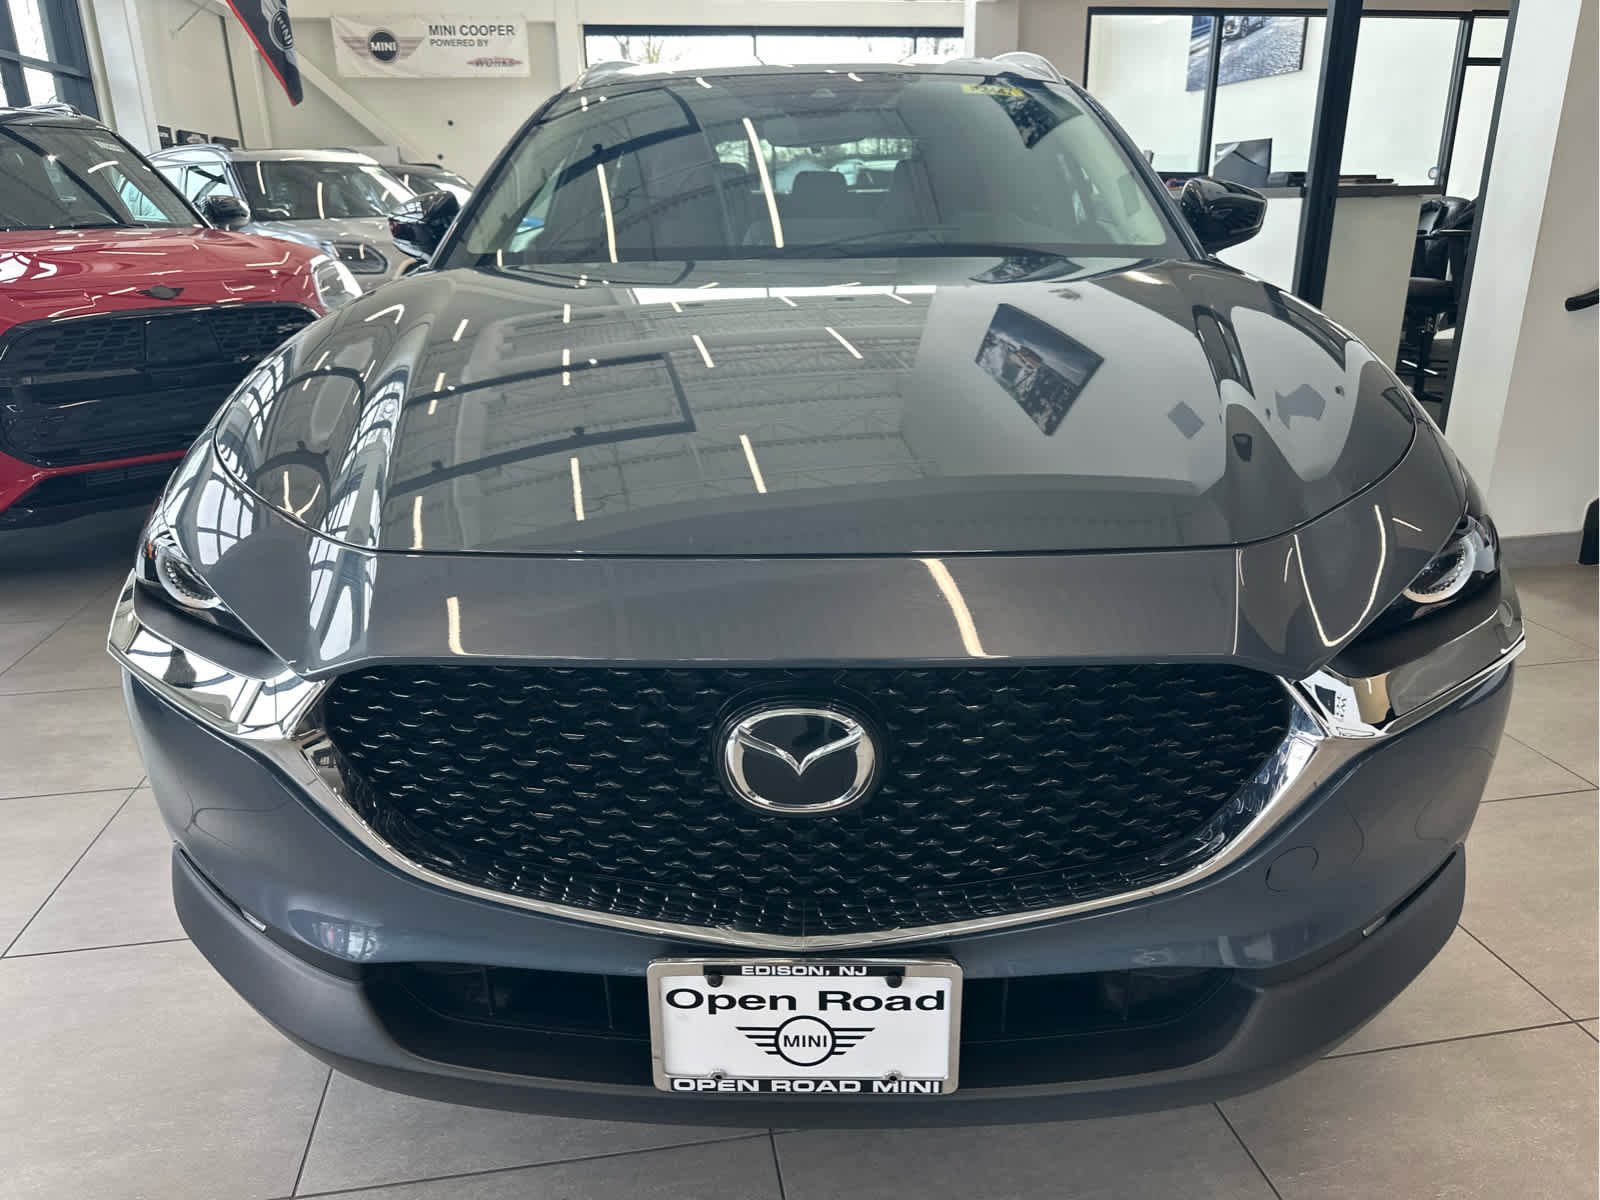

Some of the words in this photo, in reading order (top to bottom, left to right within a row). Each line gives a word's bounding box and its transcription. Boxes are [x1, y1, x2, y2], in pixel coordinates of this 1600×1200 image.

[428, 25, 456, 36] MINI
[459, 24, 515, 36] COOPER
[369, 41, 397, 52] MINI
[430, 38, 476, 47] POWERED
[477, 39, 488, 47] BY
[740, 965, 830, 976] EDISON,
[839, 966, 868, 976] NJ
[665, 987, 797, 1015] Open
[817, 990, 945, 1012] Road
[782, 1034, 828, 1048] MINI
[672, 1078, 760, 1092] OPEN
[770, 1079, 862, 1093] ROAD
[871, 1080, 941, 1094] MINI
